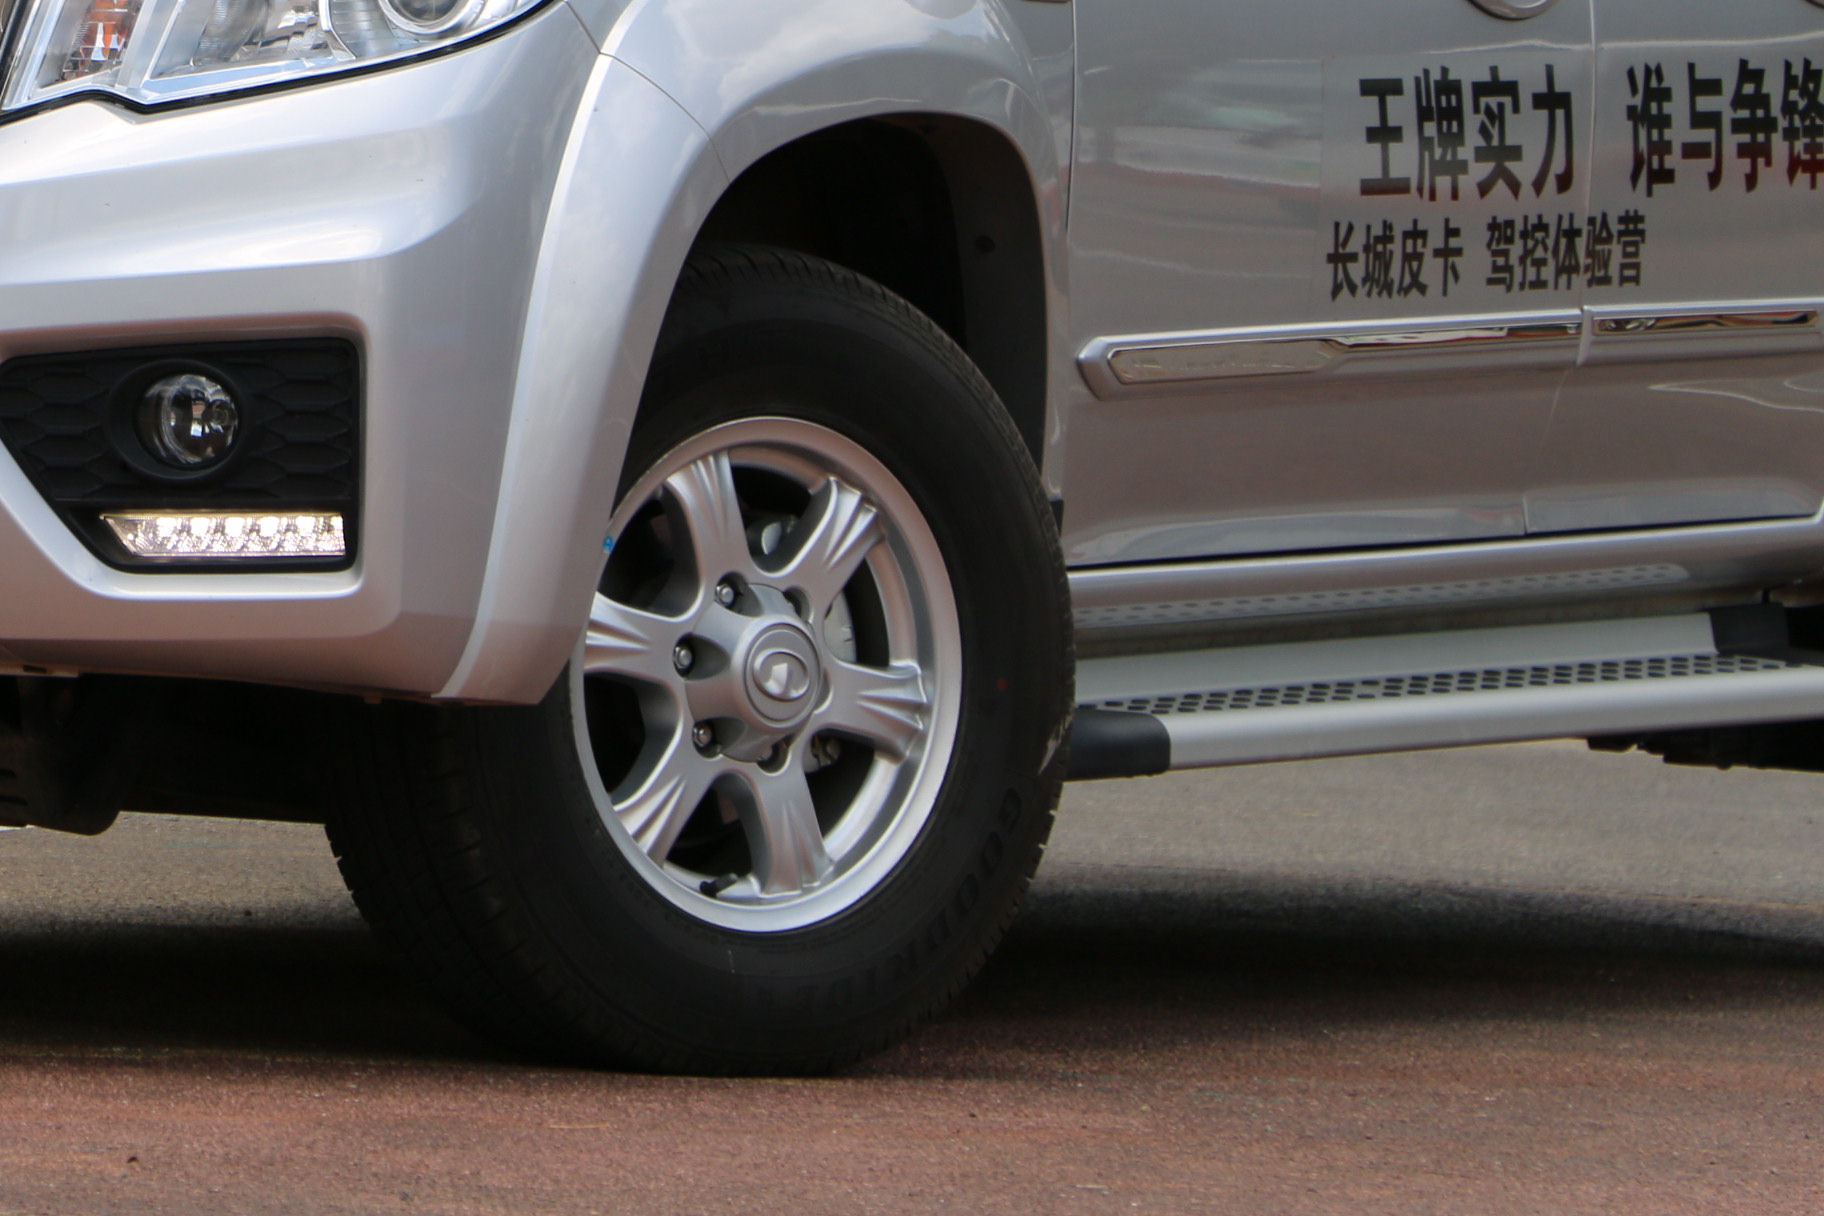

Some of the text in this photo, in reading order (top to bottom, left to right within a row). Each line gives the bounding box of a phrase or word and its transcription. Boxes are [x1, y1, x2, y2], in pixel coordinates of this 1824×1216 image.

[1358, 56, 1824, 202] 王牌实力 谁与争锋
[1326, 208, 1646, 302] 长城皮卡 驾控体验营
[796, 786, 1024, 1011] GOODRIDE
